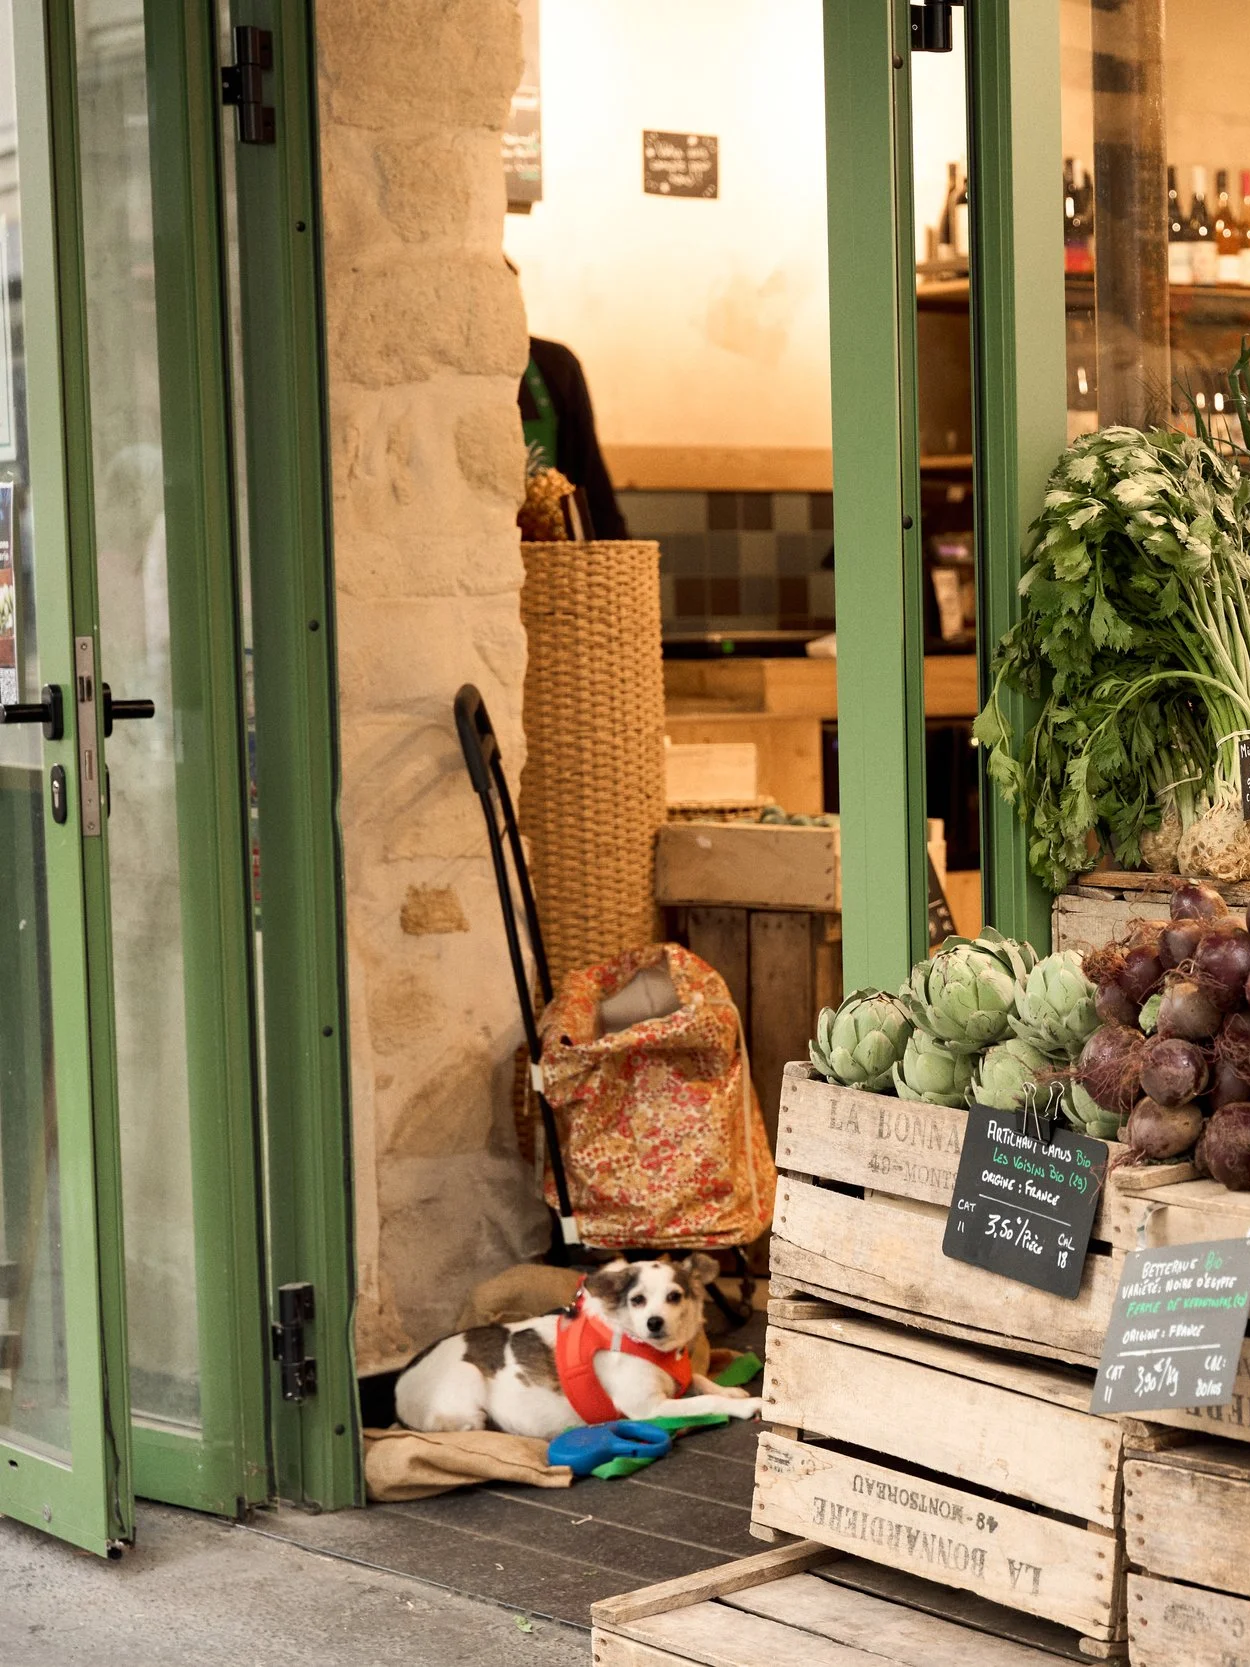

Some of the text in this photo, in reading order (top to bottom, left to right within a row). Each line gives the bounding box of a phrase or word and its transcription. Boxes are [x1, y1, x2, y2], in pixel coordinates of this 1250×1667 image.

[828, 1099, 861, 1135] LA
[1024, 1179, 1061, 1207] FRANCE
[957, 1199, 977, 1213] CAT
[1057, 1232, 1076, 1252] CAL
[1056, 1250, 1069, 1269] 18
[1168, 1324, 1205, 1339] FRANCE
[1105, 1364, 1126, 1380] CAT
[1006, 1558, 1043, 1597] LA
